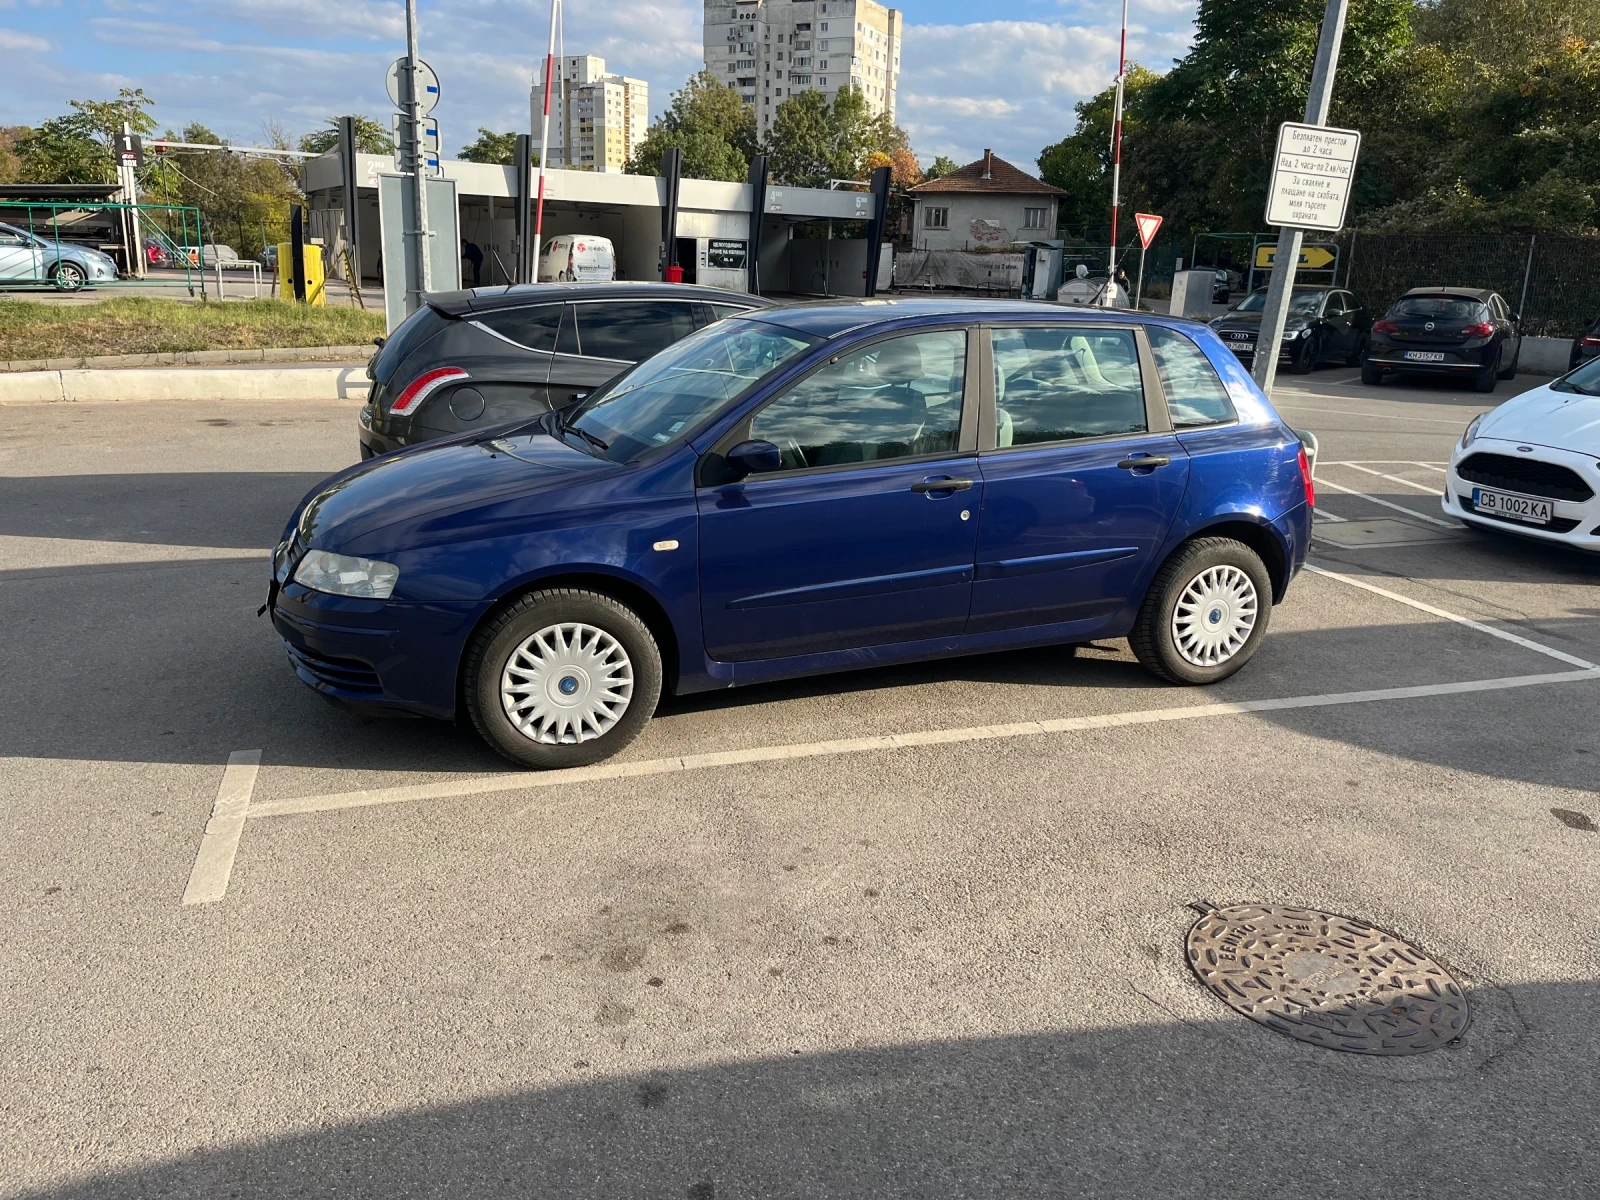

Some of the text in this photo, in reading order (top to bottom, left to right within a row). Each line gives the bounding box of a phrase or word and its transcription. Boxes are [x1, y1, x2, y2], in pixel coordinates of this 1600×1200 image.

[122, 136, 132, 151] 1
[1292, 130, 1347, 146] Безплатен престой
[1303, 145, 1333, 156] до 2 часа
[122, 159, 137, 167] BOX
[367, 160, 375, 175] 2
[1280, 157, 1292, 168] Над
[1294, 159, 1299, 168] 2
[1292, 176, 1300, 185] За
[1302, 179, 1325, 188] сваляне
[770, 190, 776, 203] 4
[1280, 188, 1306, 197] плащане
[1308, 190, 1315, 198] на
[855, 196, 861, 208] 5
[1289, 200, 1327, 211] моля търсете
[1292, 211, 1319, 221] охраната.
[1480, 493, 1548, 518] CB 1002 KA
